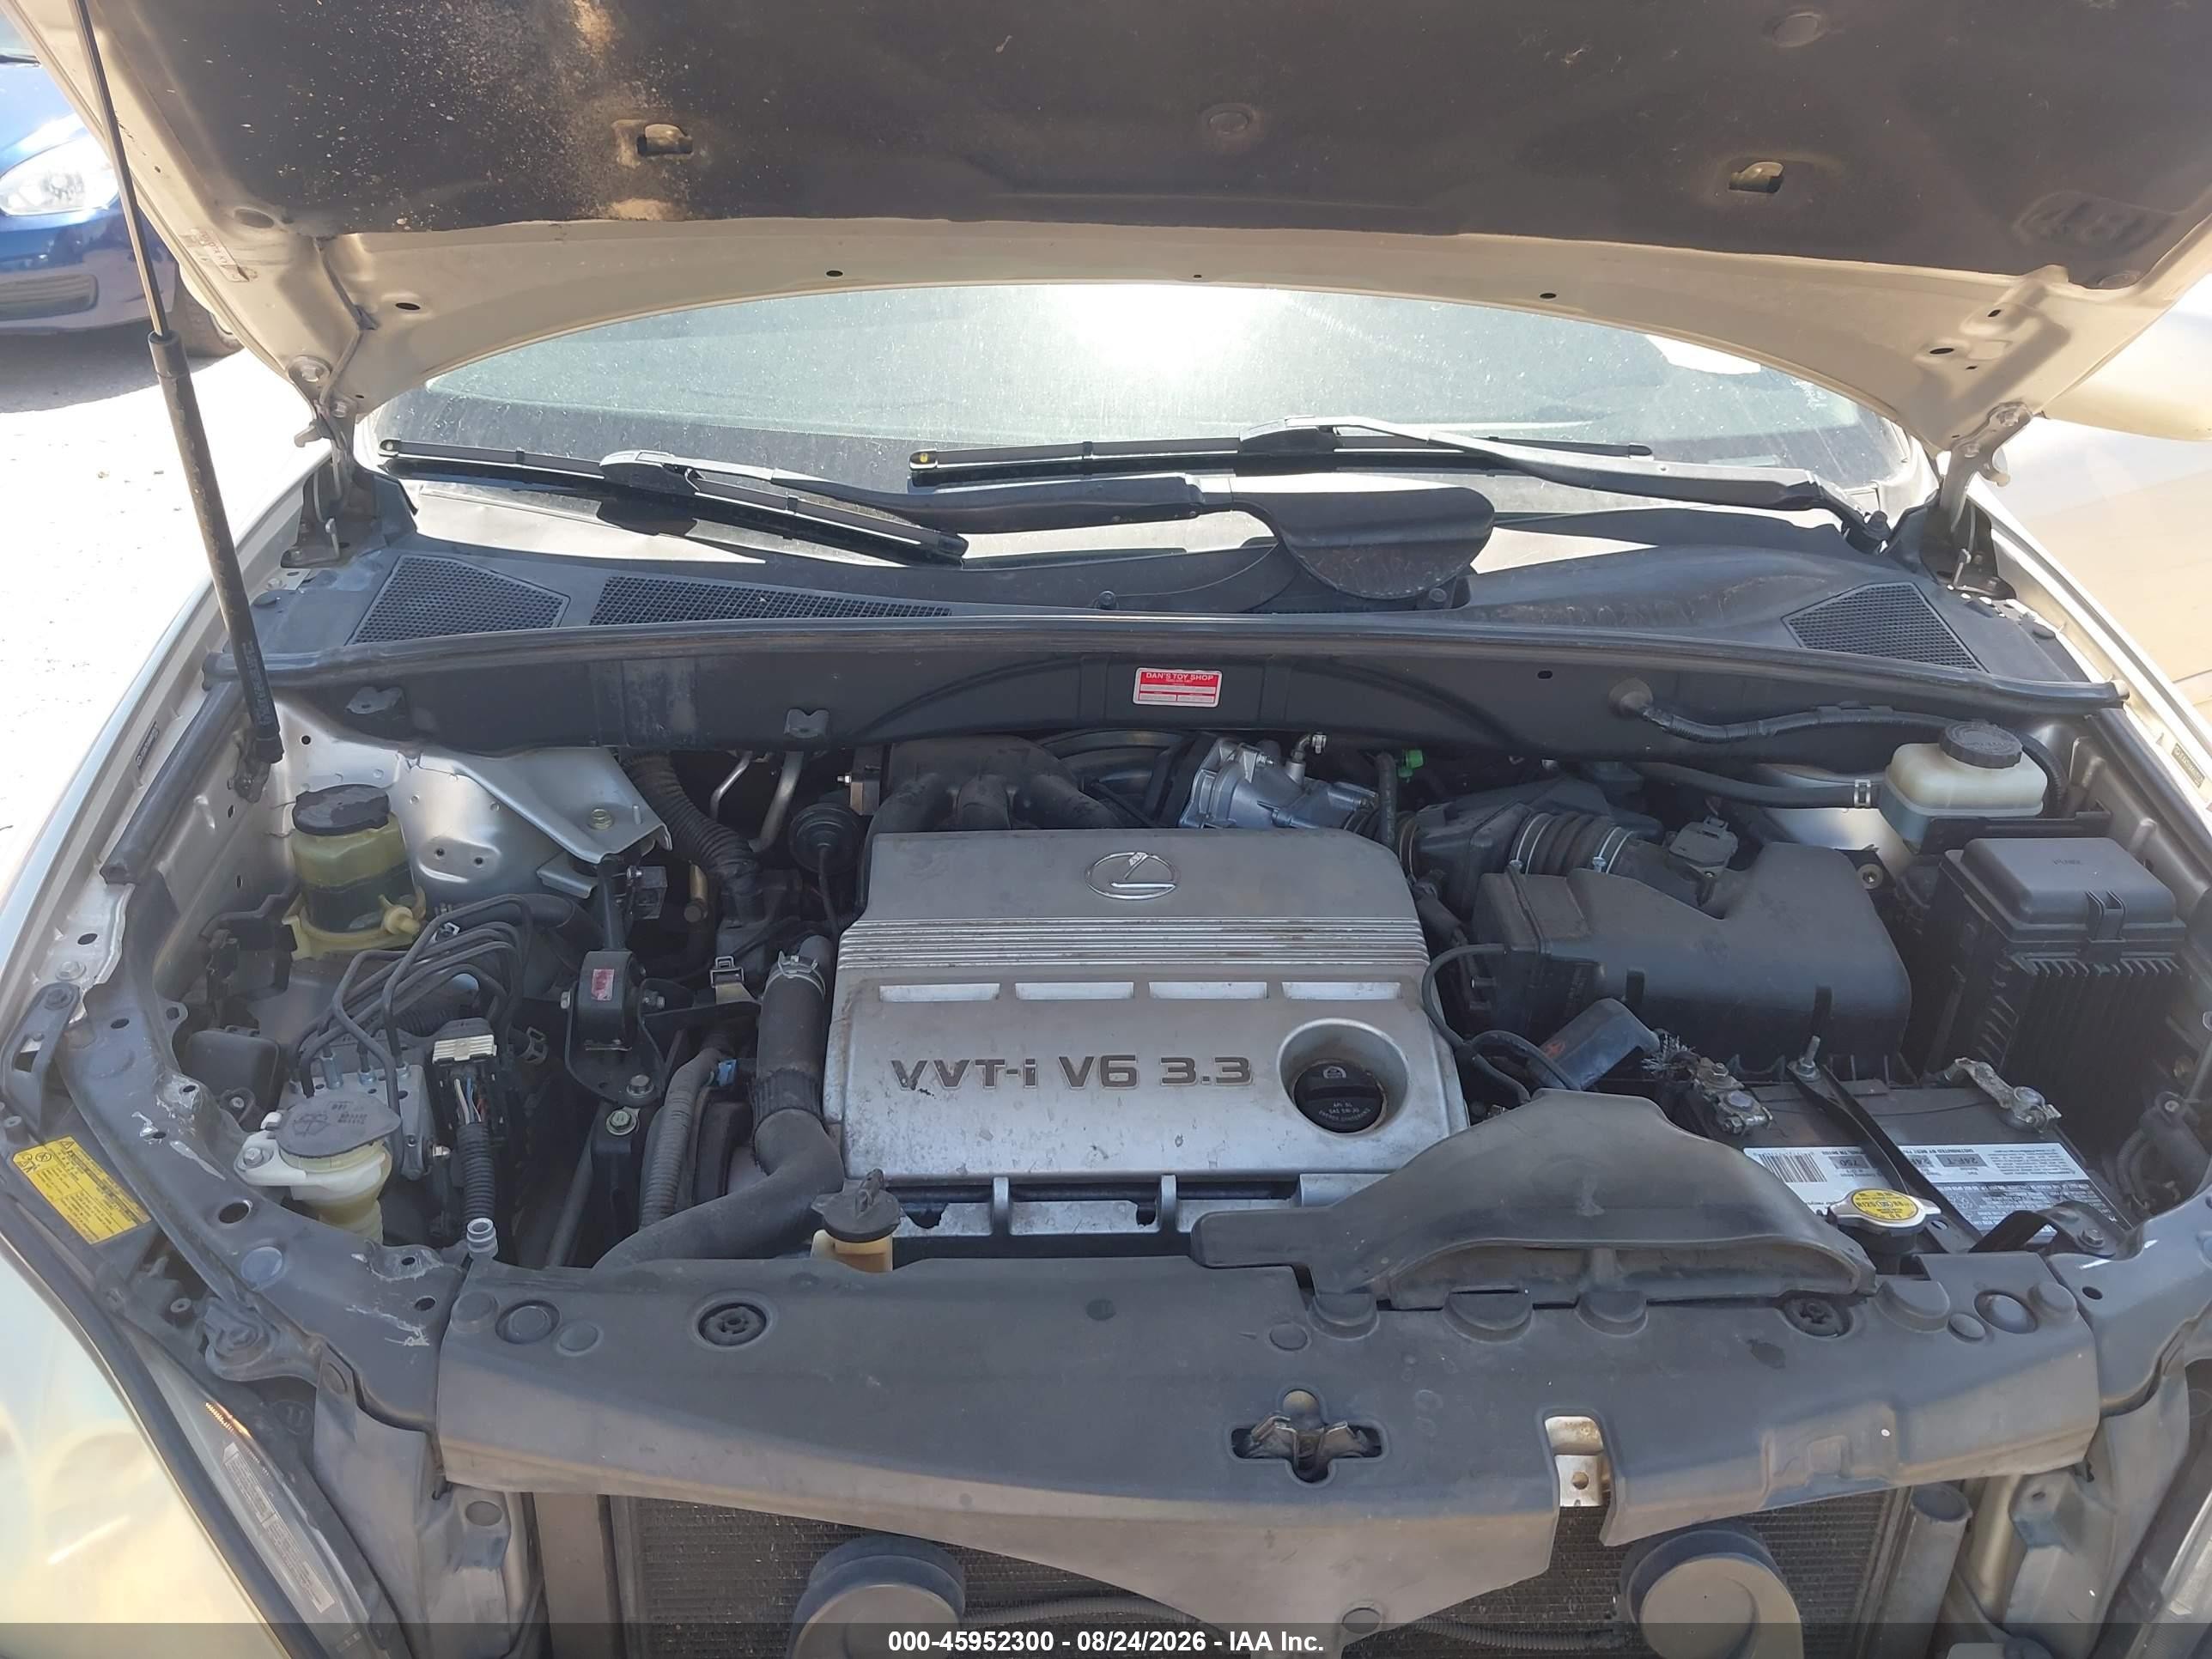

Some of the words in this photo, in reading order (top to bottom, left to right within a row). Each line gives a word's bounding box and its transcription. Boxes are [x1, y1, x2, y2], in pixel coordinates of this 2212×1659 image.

[890, 1056, 1038, 1090] VVT-i
[1059, 1054, 1139, 1089] V6
[1159, 1055, 1253, 1086] 3.3
